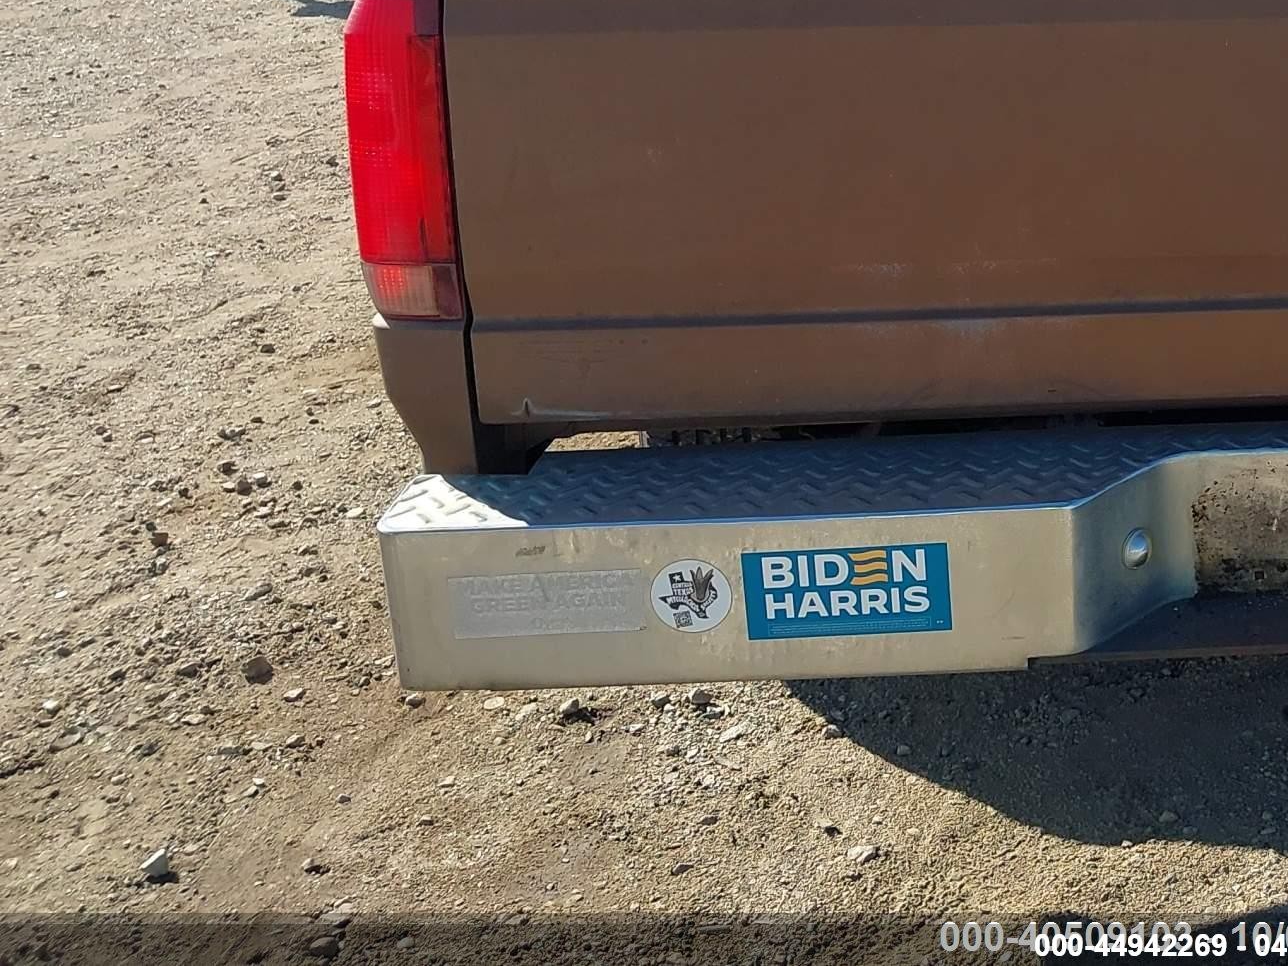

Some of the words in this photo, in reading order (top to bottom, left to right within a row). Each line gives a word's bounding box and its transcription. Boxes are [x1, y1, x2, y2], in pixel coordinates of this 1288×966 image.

[761, 548, 927, 589] BIDEN
[673, 587, 694, 596] TEXAS
[765, 585, 930, 620] HARRIS
